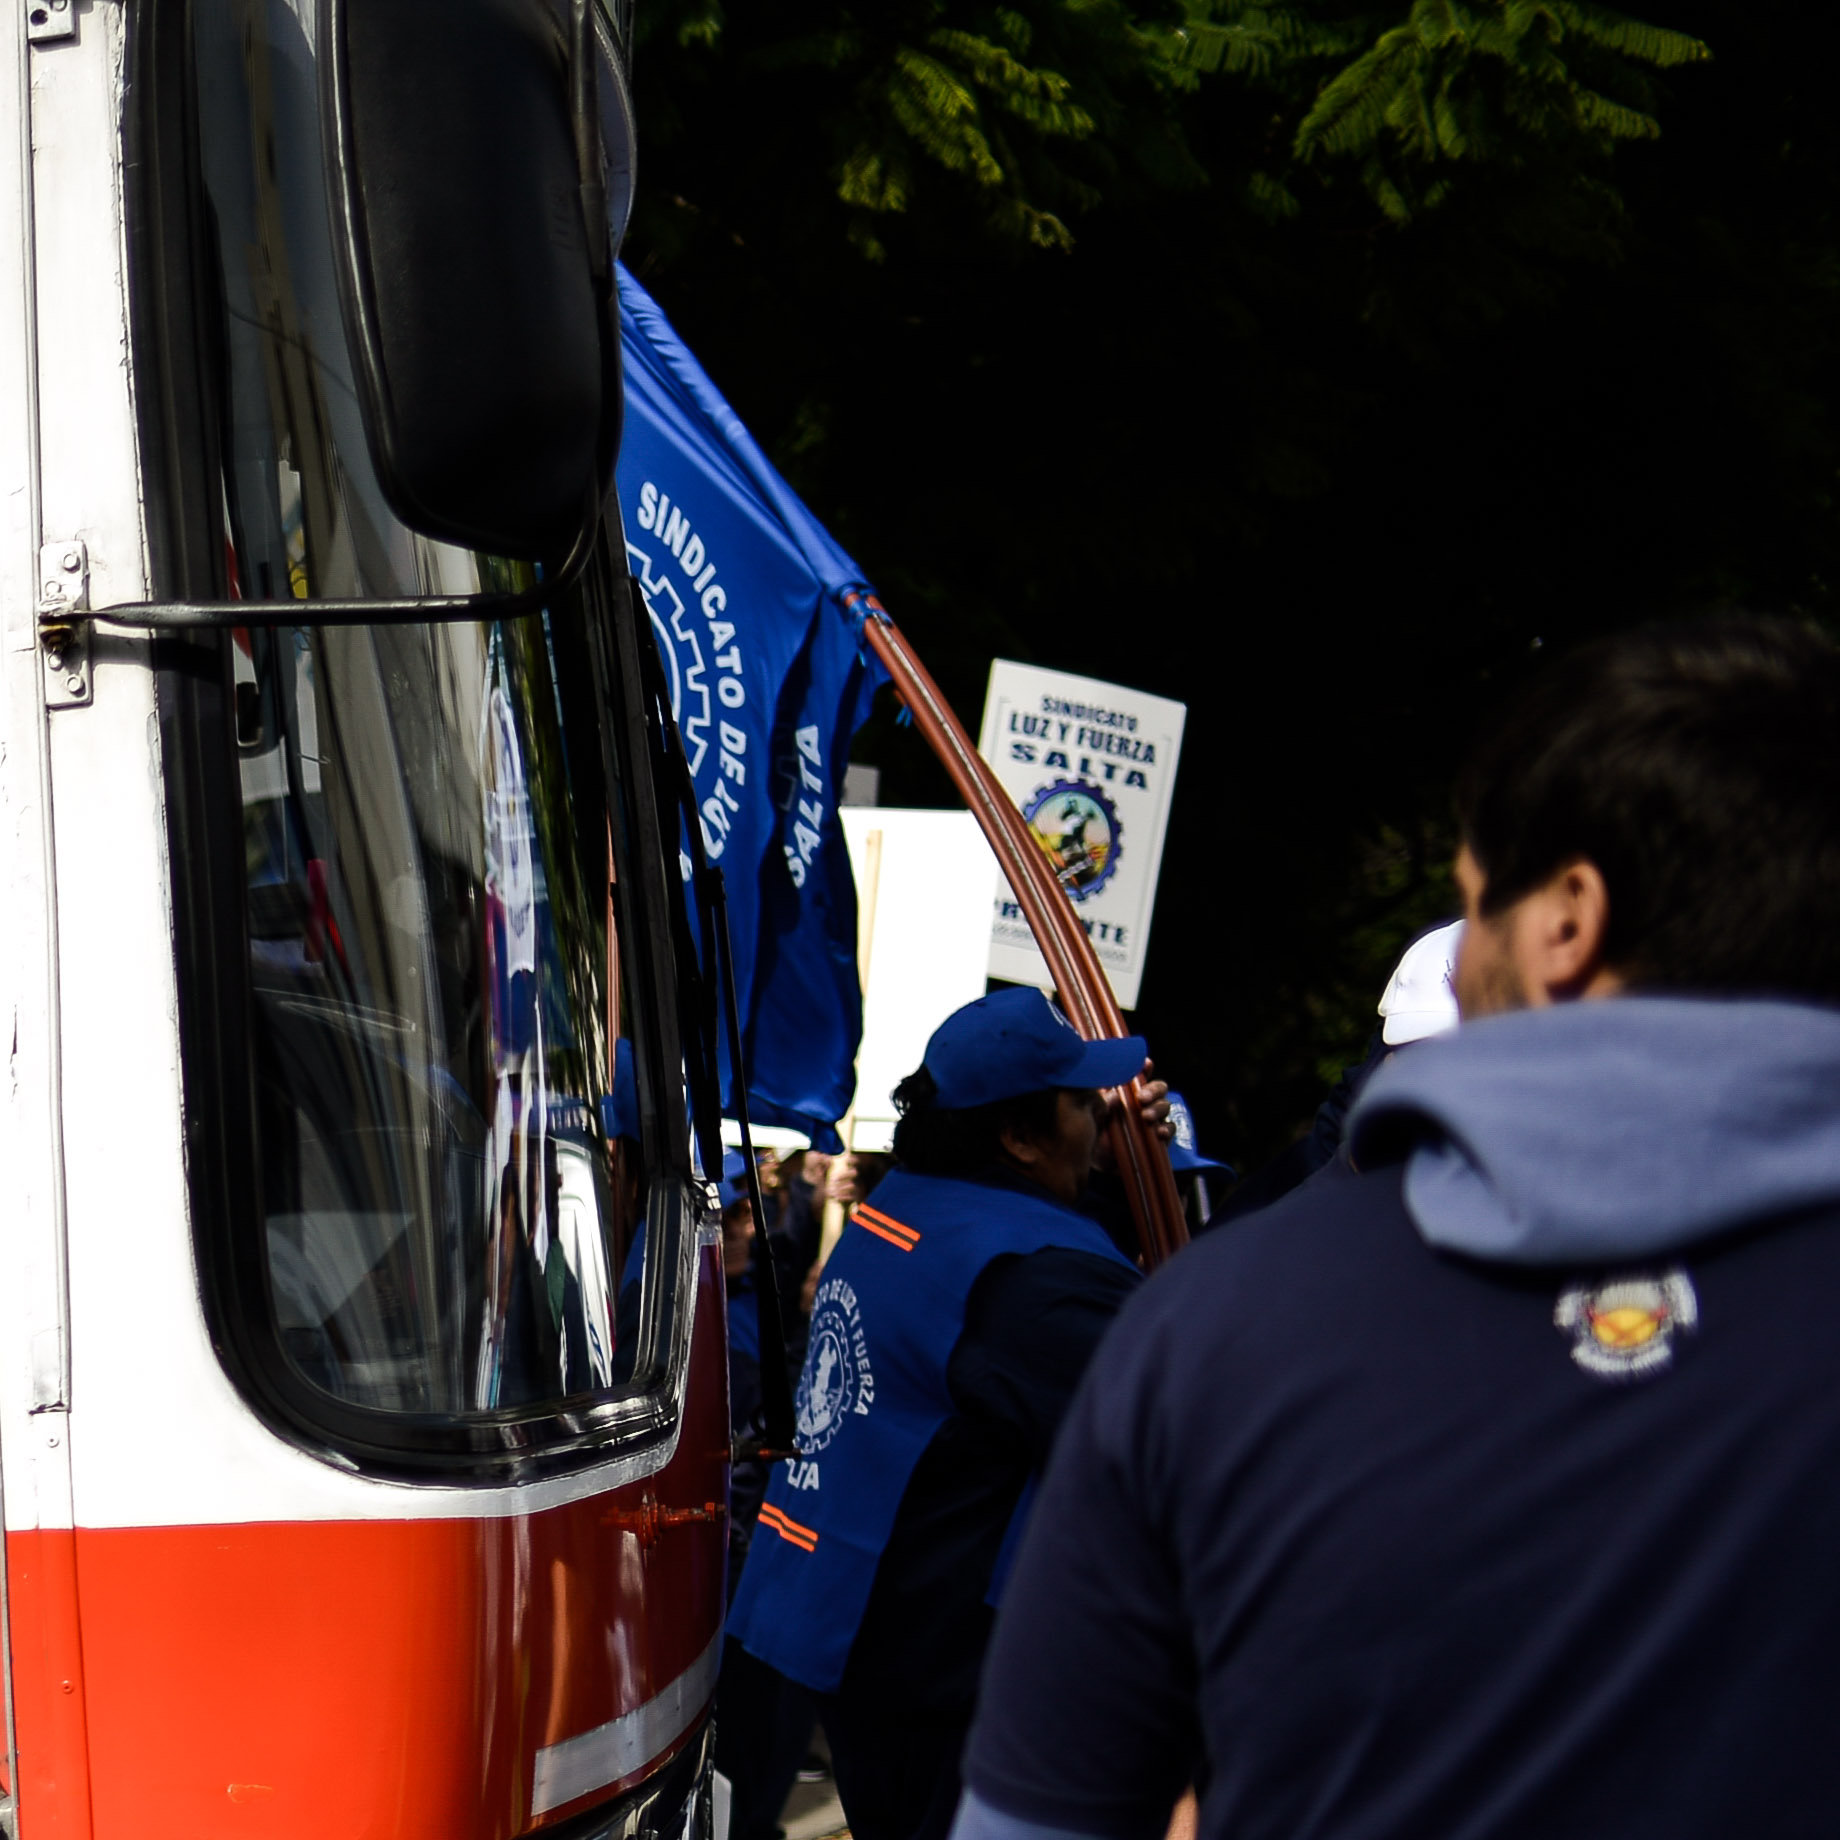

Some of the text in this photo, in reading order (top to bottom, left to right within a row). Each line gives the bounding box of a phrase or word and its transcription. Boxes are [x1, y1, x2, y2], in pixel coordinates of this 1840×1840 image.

[637, 481, 745, 708] SINDICATO
[720, 720, 746, 786] DE
[1010, 712, 1156, 765] LUZ Y FUERZA
[1041, 697, 1138, 732] SINDICATO
[1011, 742, 1148, 789] SALTA
[852, 1327, 875, 1416] FUERZA
